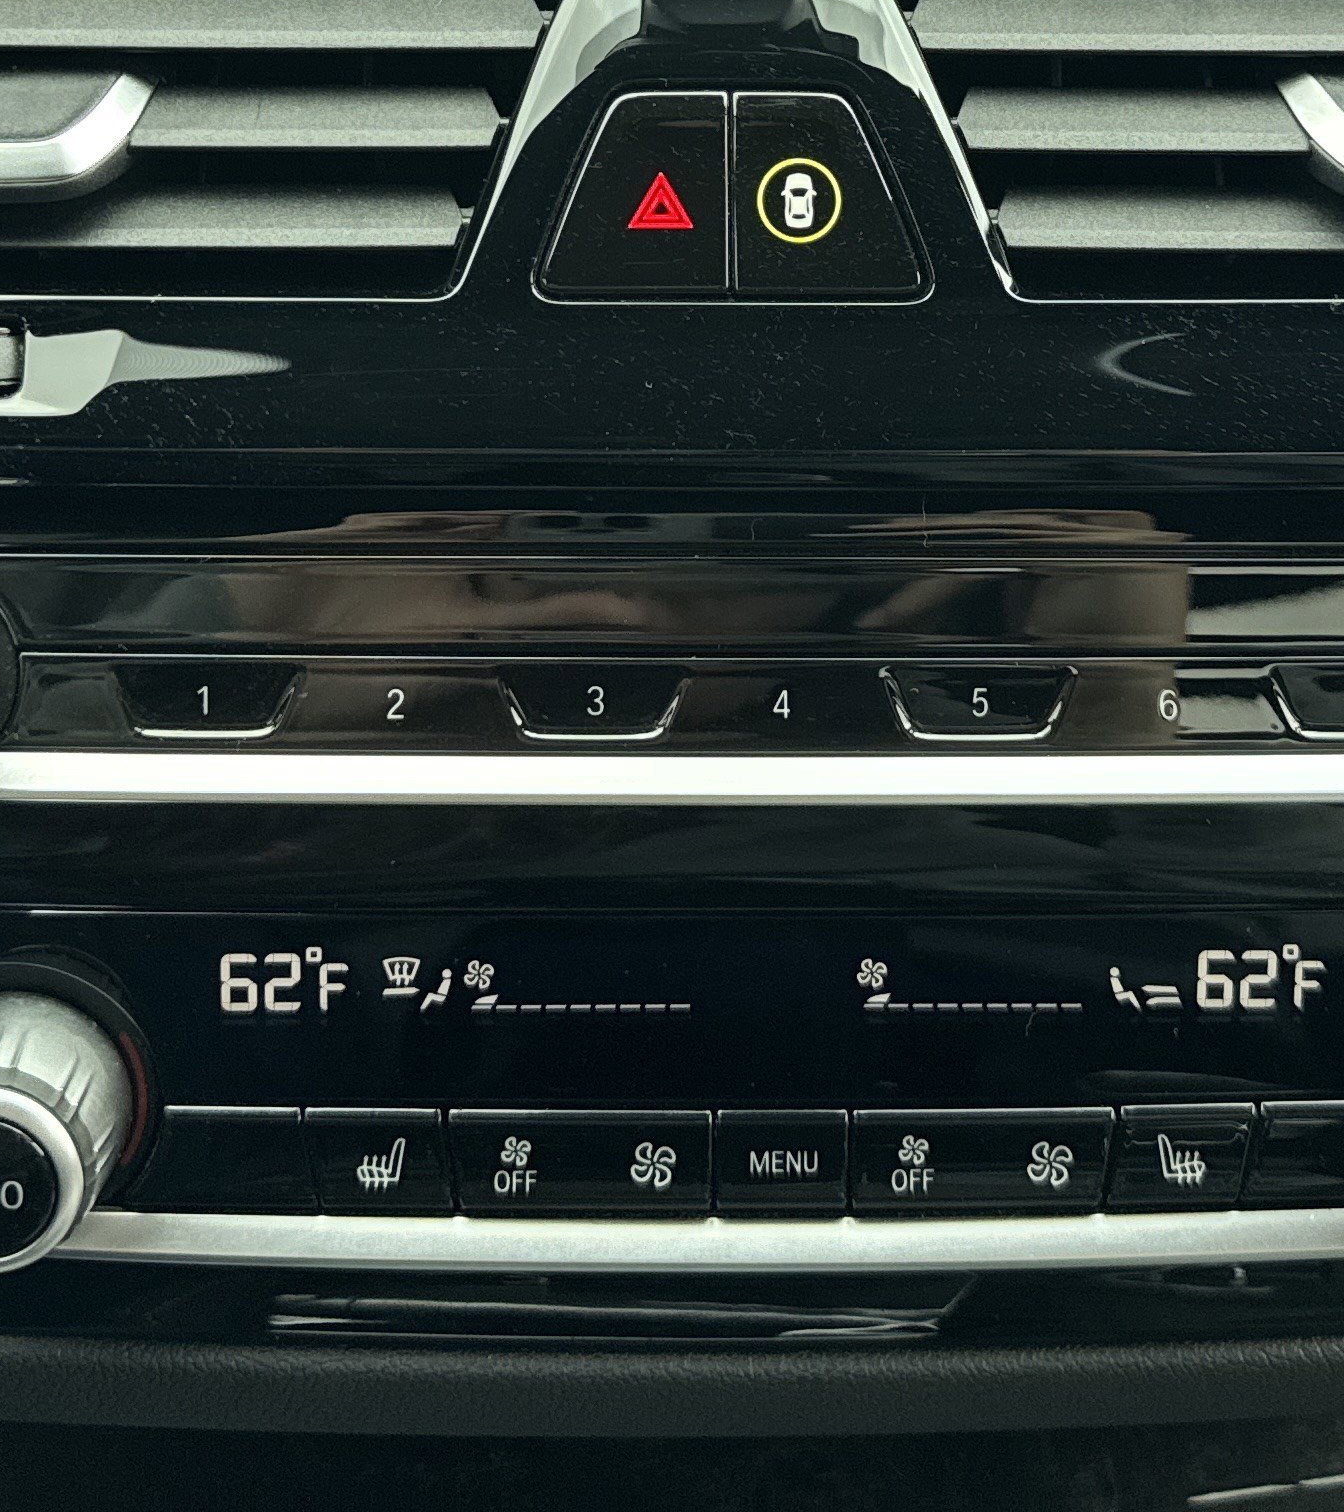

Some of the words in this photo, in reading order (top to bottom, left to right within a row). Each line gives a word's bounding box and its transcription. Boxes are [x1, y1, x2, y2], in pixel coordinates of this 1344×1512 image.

[197, 686, 210, 715] 1
[386, 689, 405, 721] 2
[587, 686, 605, 716] 3
[773, 690, 790, 719] 4
[971, 688, 989, 717] 5
[1157, 690, 1179, 722] 6
[749, 1150, 819, 1176] MENU
[493, 1169, 537, 1193] OFF
[891, 1169, 935, 1192] OFF
